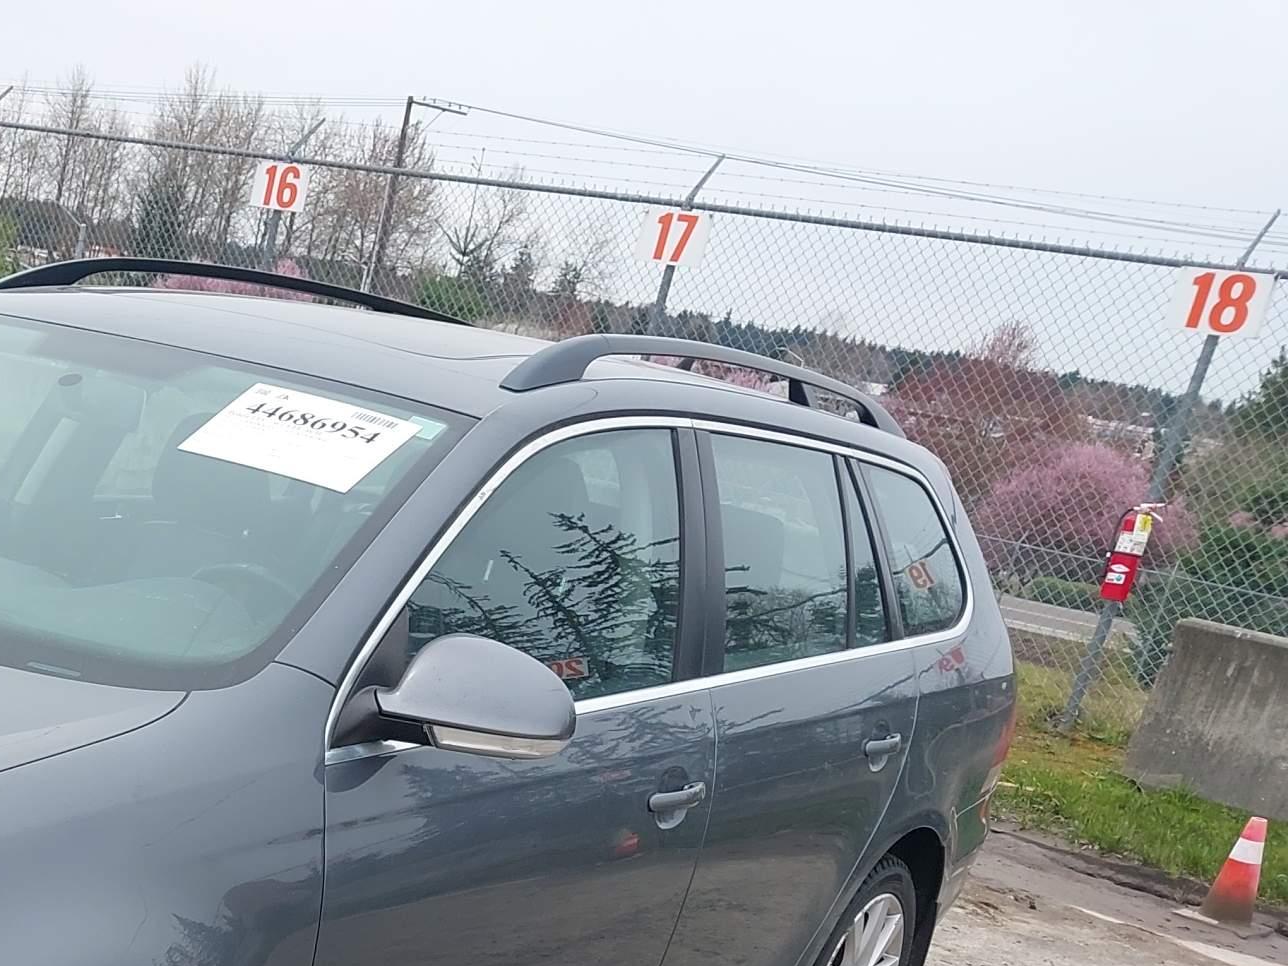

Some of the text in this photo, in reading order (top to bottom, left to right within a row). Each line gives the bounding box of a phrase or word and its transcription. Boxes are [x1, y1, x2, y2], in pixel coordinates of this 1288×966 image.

[263, 165, 300, 208] 16
[653, 212, 700, 262] 17
[1185, 272, 1257, 333] 18
[245, 402, 382, 444] 44686954
